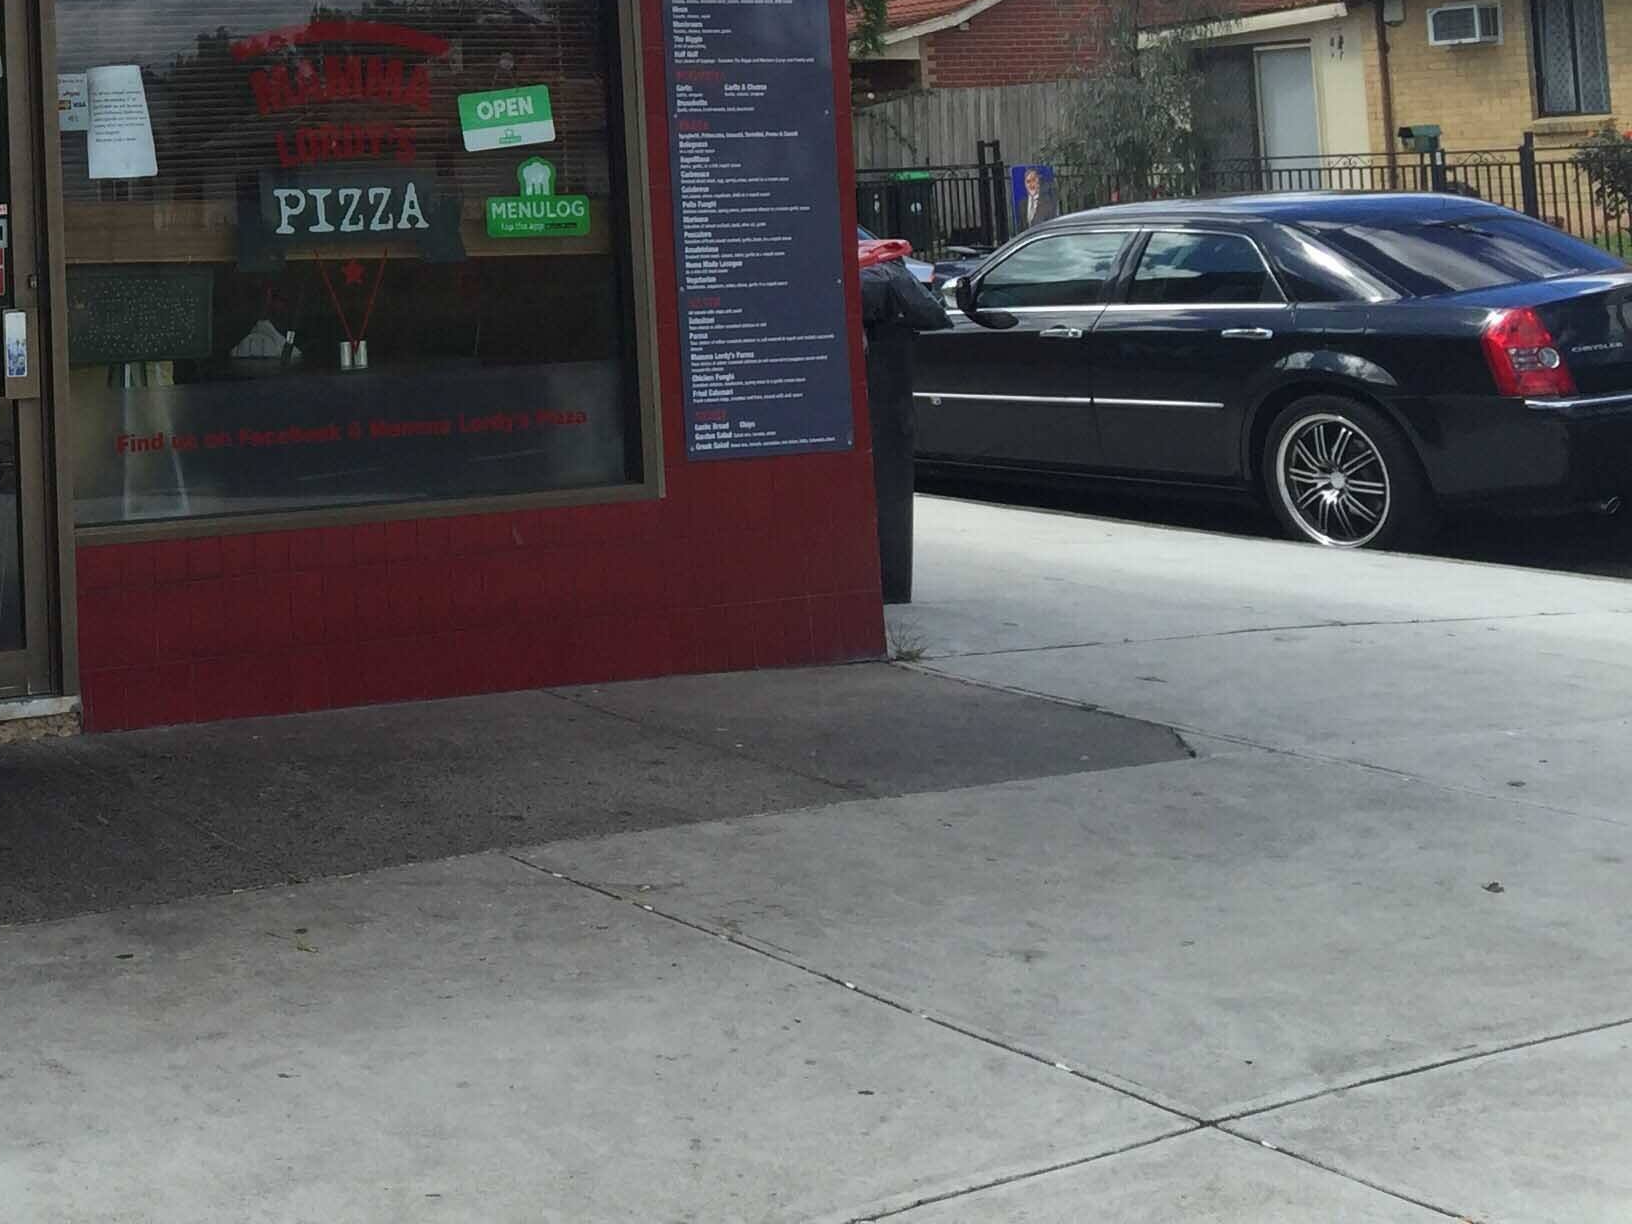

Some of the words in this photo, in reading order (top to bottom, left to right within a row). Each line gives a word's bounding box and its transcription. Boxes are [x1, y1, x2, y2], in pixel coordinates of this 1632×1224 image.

[250, 54, 432, 115] MAMMA
[476, 95, 534, 121] OPEN
[274, 122, 416, 168] LORDY'S
[273, 182, 430, 235] PIZZA
[491, 199, 584, 220] MENULOG
[116, 434, 163, 454] Find
[172, 436, 196, 451] us
